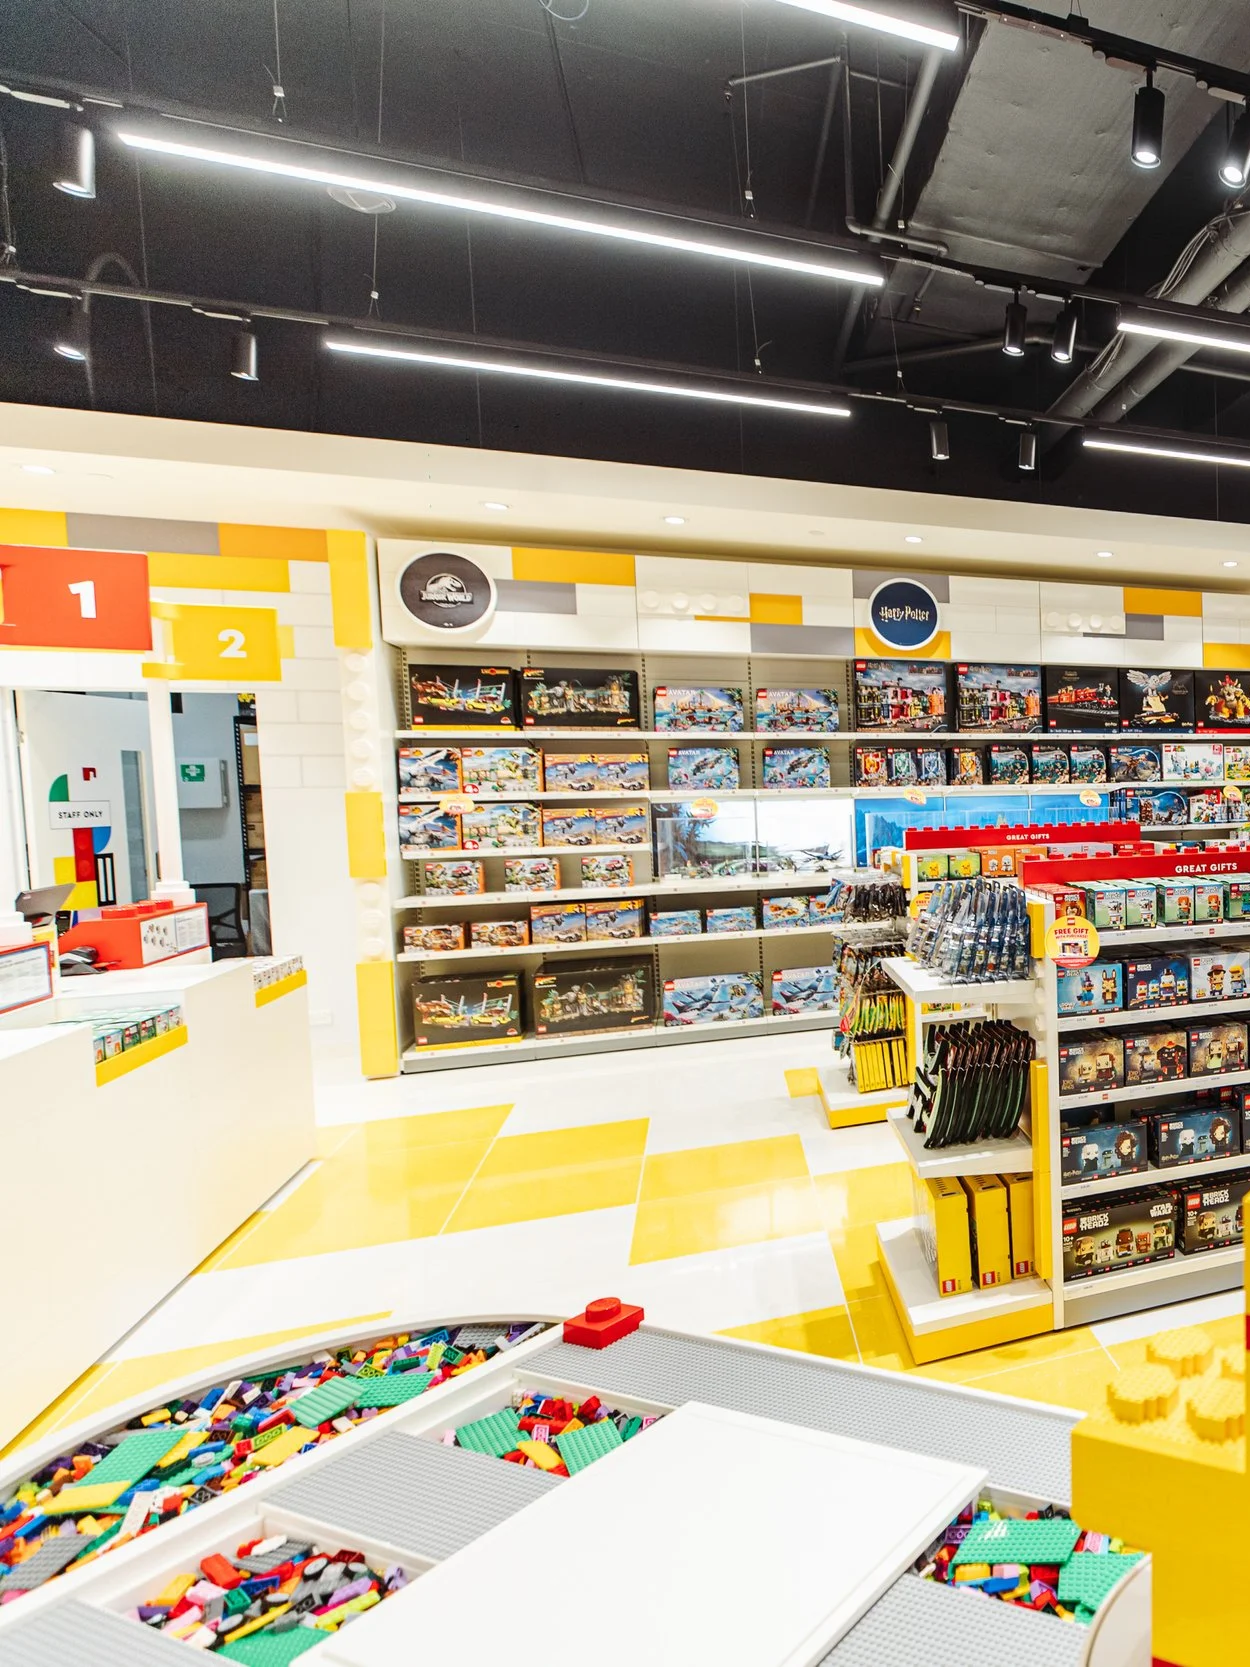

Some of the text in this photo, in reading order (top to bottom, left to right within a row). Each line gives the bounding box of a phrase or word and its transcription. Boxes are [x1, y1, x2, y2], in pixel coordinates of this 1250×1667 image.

[67, 579, 98, 620] 1
[879, 605, 930, 623] Harry Potter
[216, 628, 249, 659] 2
[58, 810, 103, 820] STAFF ONLY
[1174, 862, 1238, 874] GREAT GIFTS
[1054, 927, 1090, 936] FREE GIFT
[1208, 1189, 1229, 1198] BRICK
[1151, 1203, 1173, 1211] STAR
[1085, 1212, 1109, 1222] BRICK
[1150, 1208, 1173, 1217] WARS
[1063, 1235, 1075, 1243] 10+
